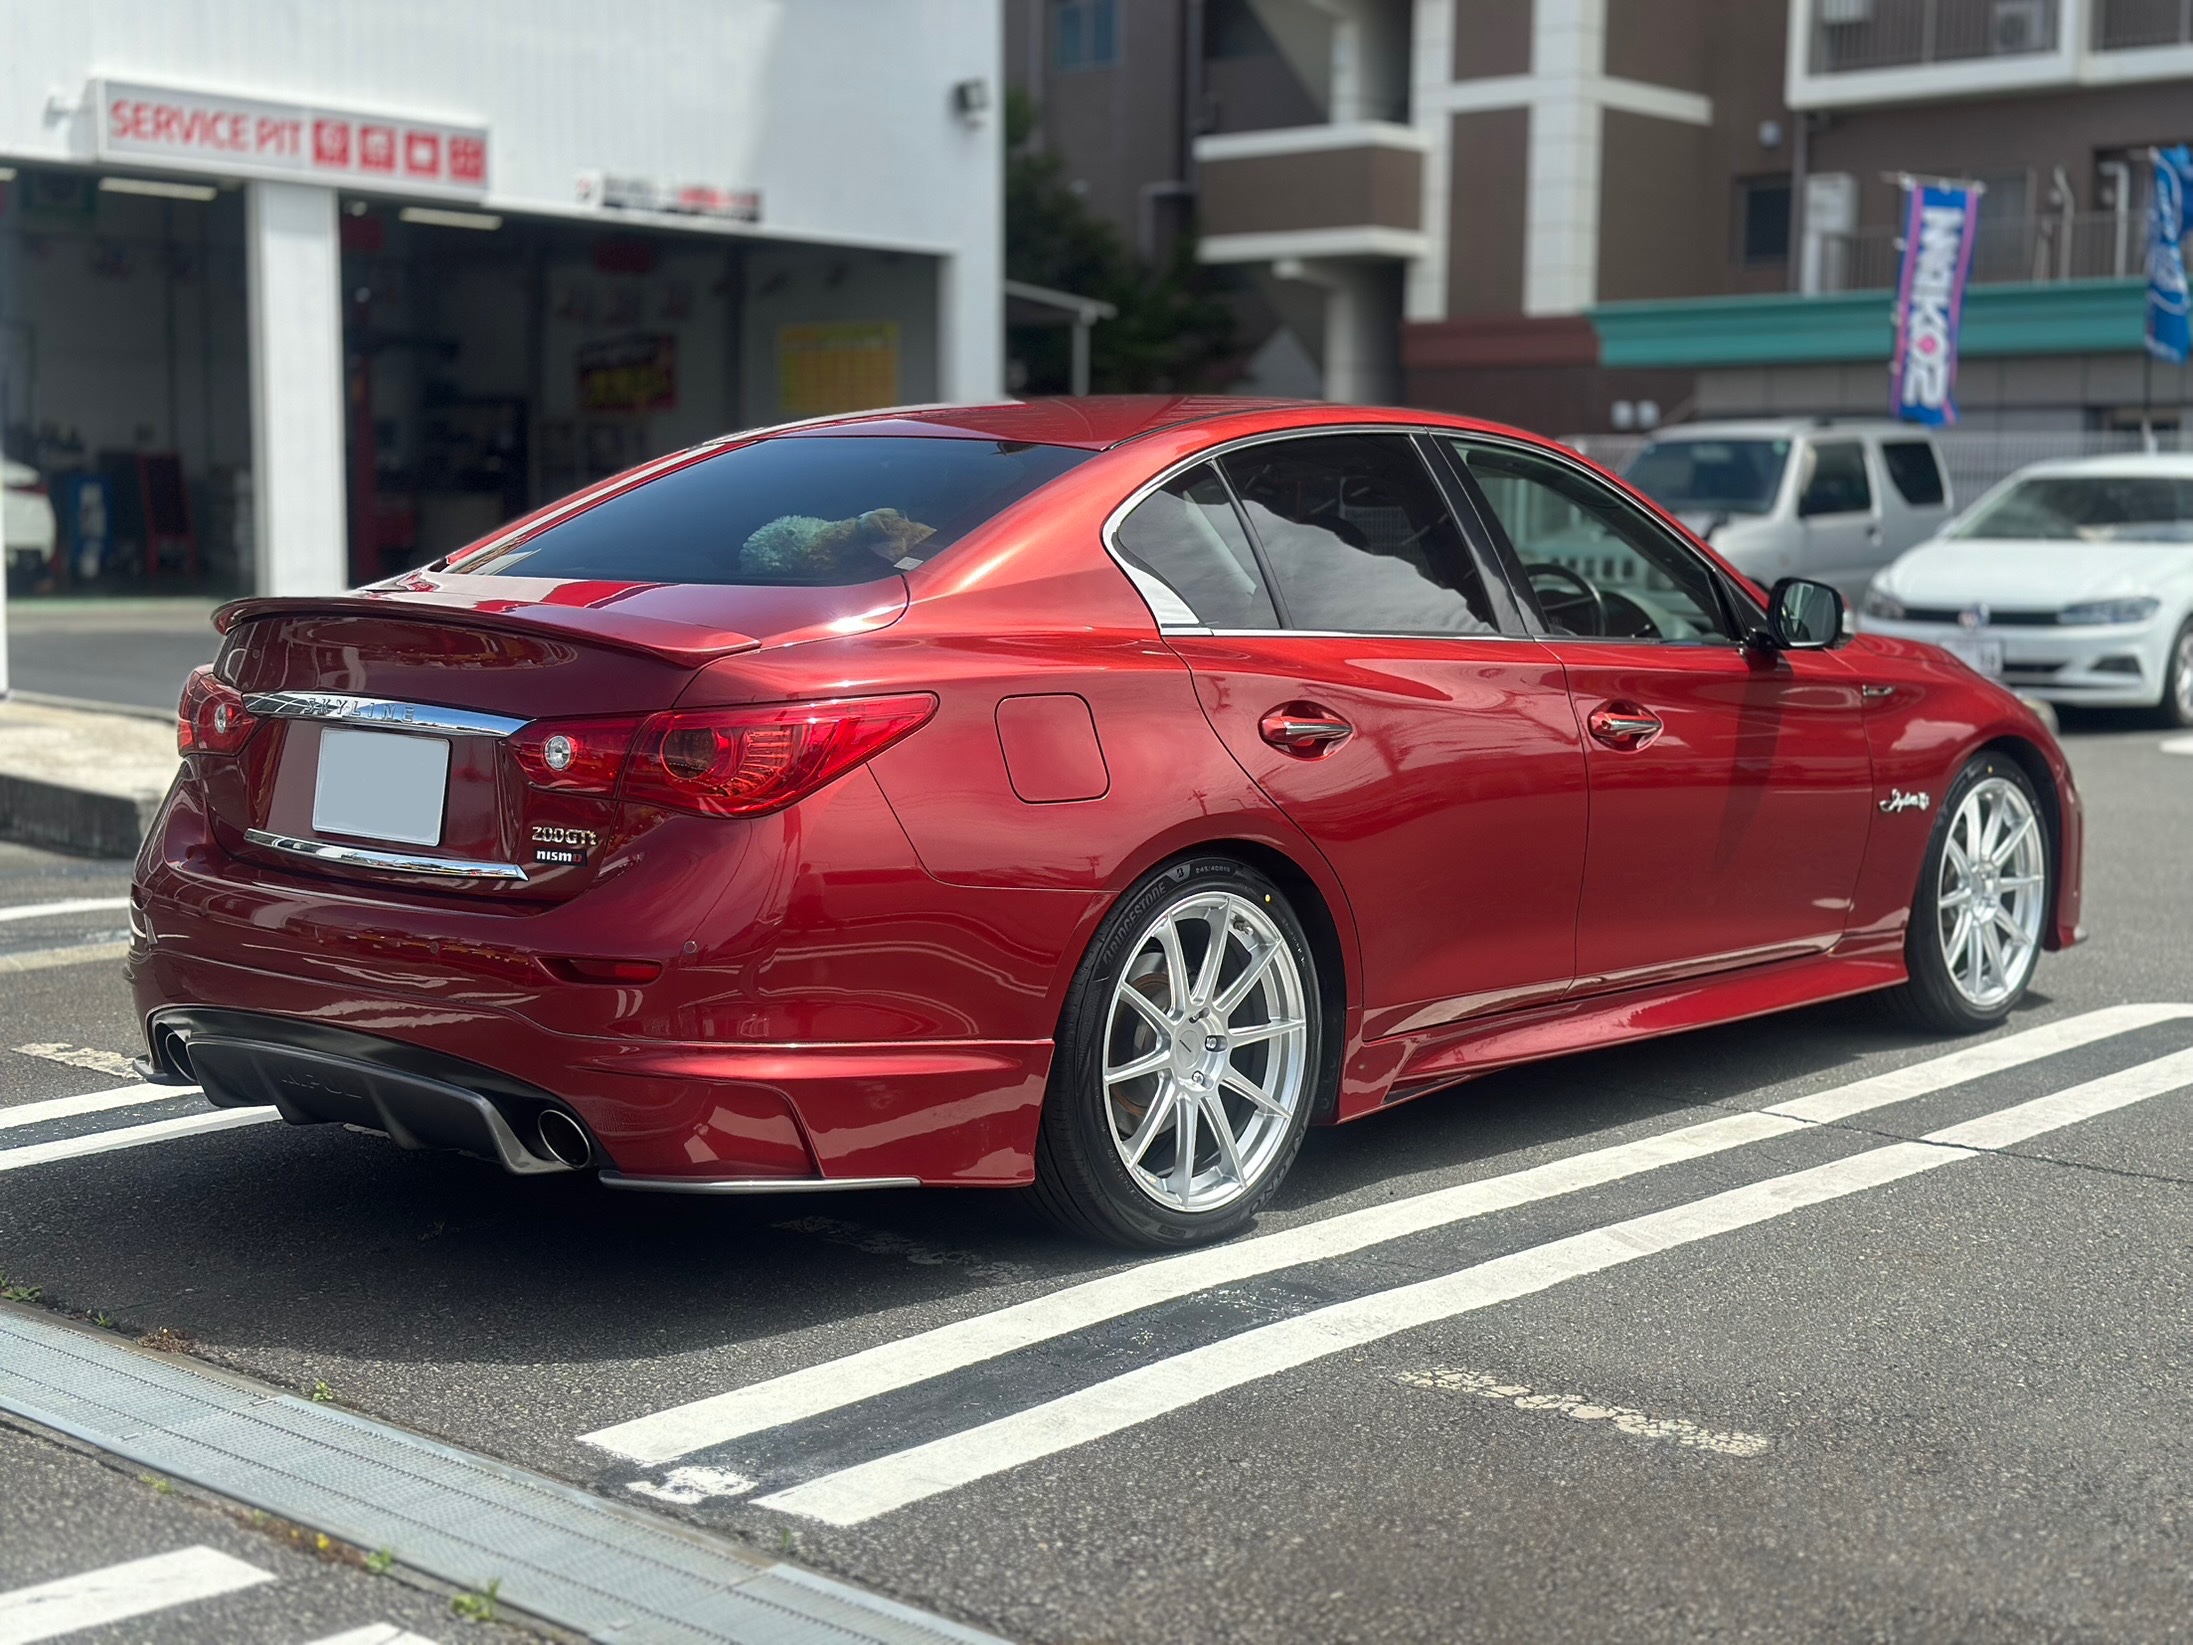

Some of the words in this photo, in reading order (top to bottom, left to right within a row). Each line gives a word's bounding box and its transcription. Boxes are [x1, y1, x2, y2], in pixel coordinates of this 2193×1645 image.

[111, 99, 249, 152] SERVICE
[255, 117, 304, 157] PIT
[304, 697, 416, 723] SKYLINE
[1102, 881, 1167, 965] BRIDGESTONE
